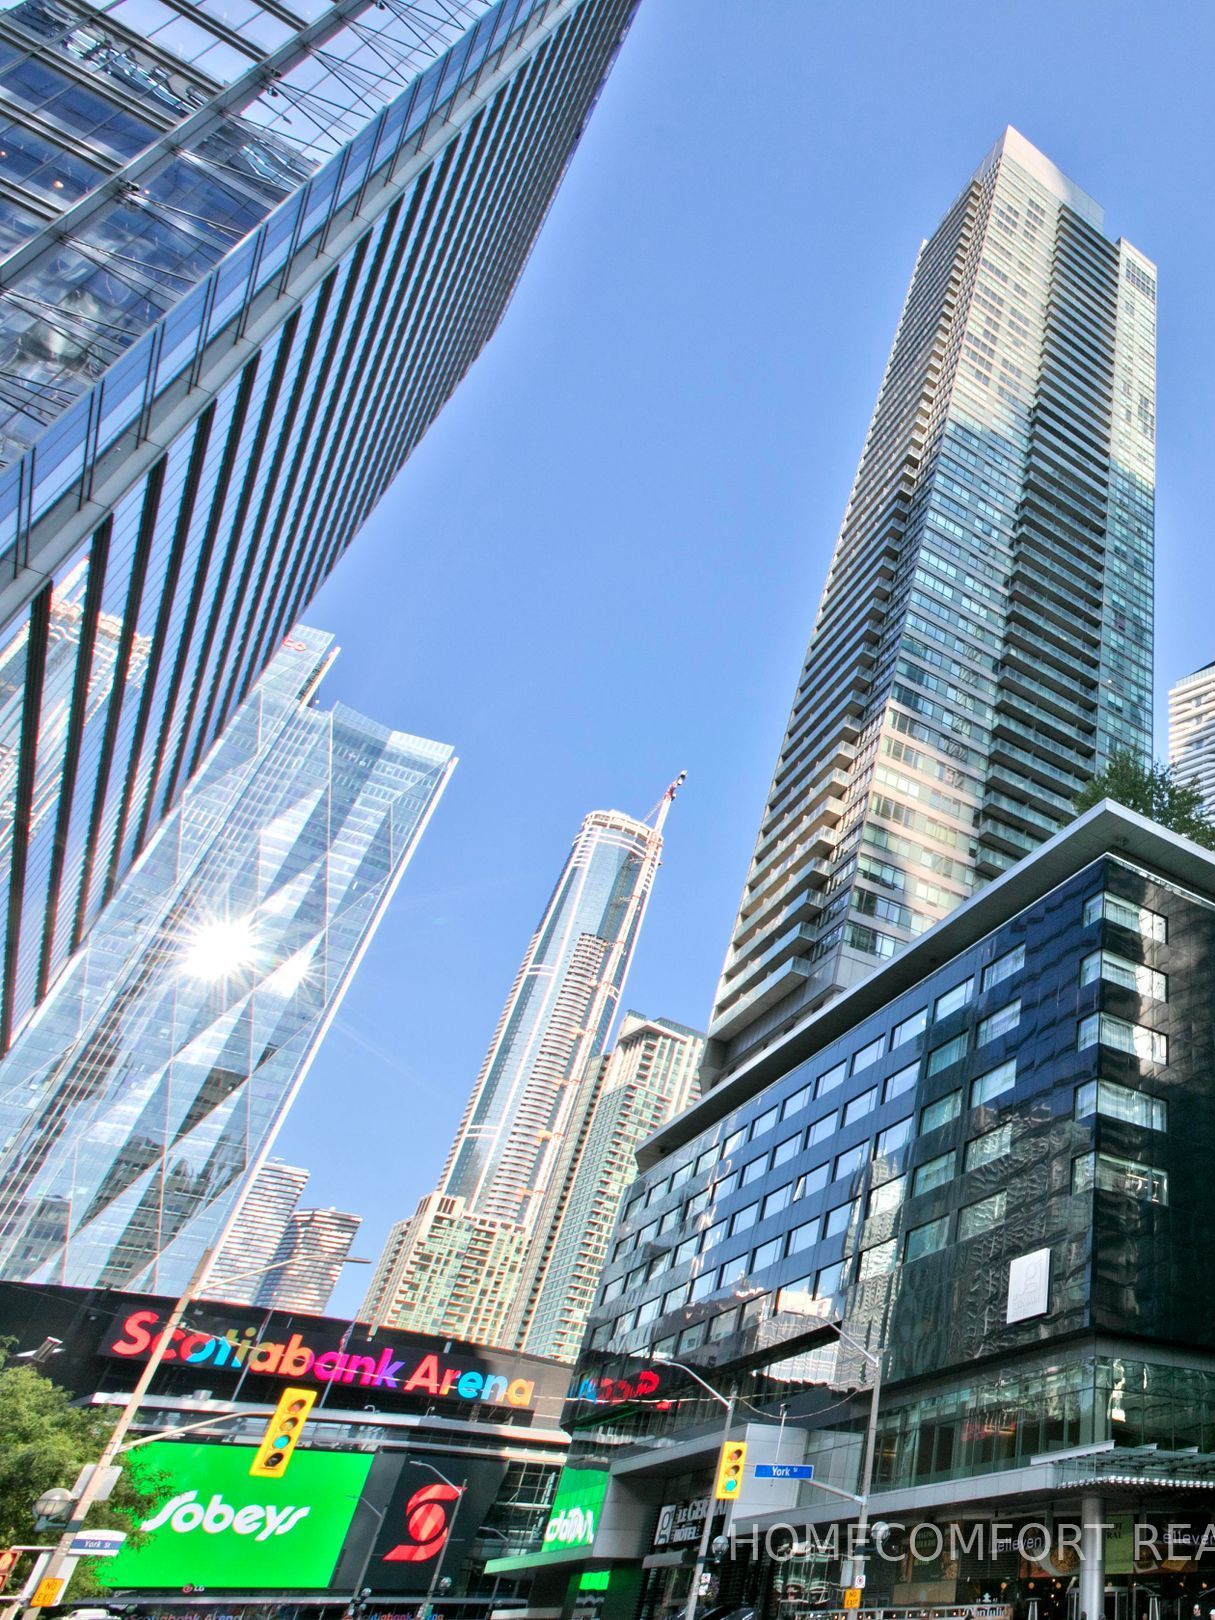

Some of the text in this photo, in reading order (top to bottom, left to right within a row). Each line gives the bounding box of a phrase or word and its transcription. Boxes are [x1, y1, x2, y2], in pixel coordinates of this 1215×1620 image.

[112, 1310, 406, 1389] Scotiabank
[403, 1354, 536, 1406] Arena
[772, 1466, 790, 1476] York
[140, 1490, 311, 1541] Sobeys
[84, 1540, 101, 1548] York
[46, 1581, 57, 1590] NO
